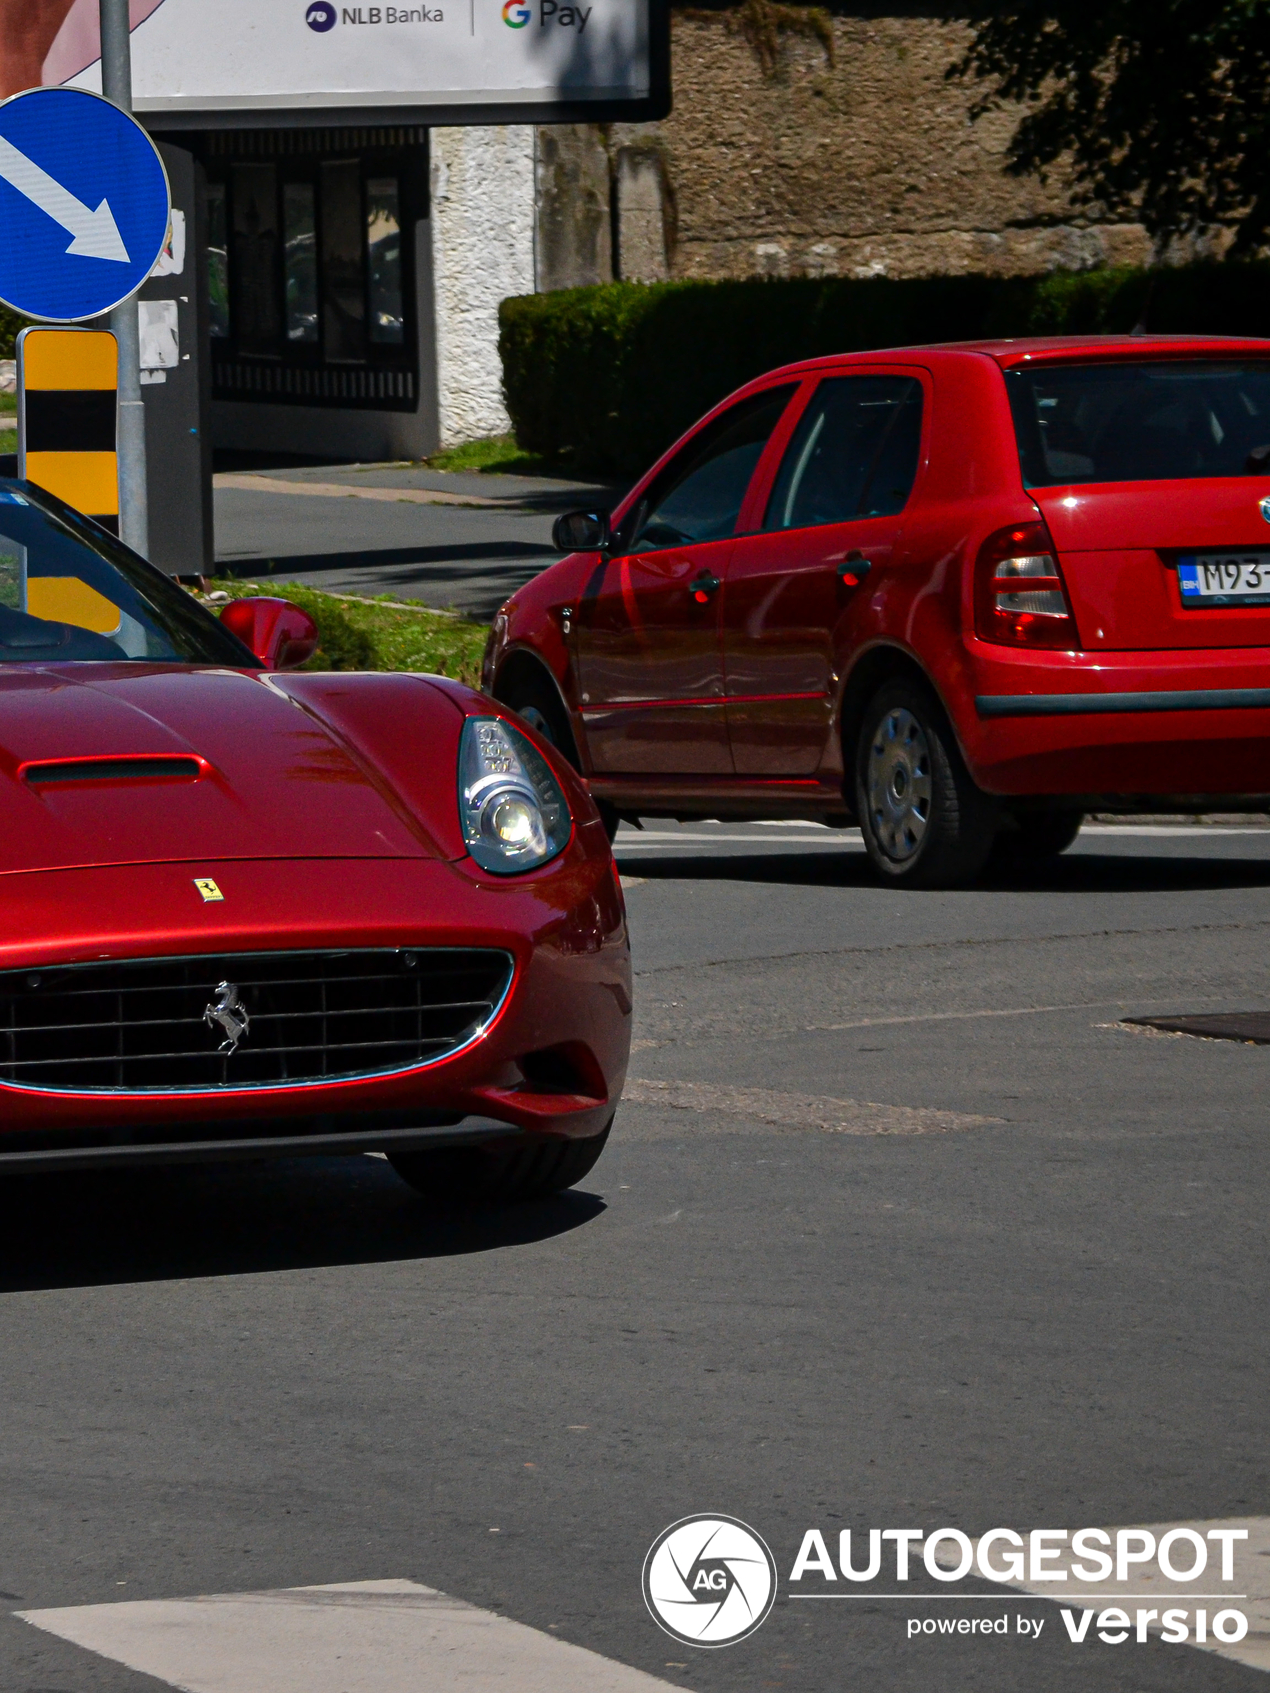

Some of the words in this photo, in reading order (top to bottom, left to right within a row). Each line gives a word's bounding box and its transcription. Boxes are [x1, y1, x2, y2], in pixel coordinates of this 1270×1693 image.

[342, 7, 382, 25] NLB
[386, 5, 444, 24] Banka
[540, 0, 592, 34] Pay
